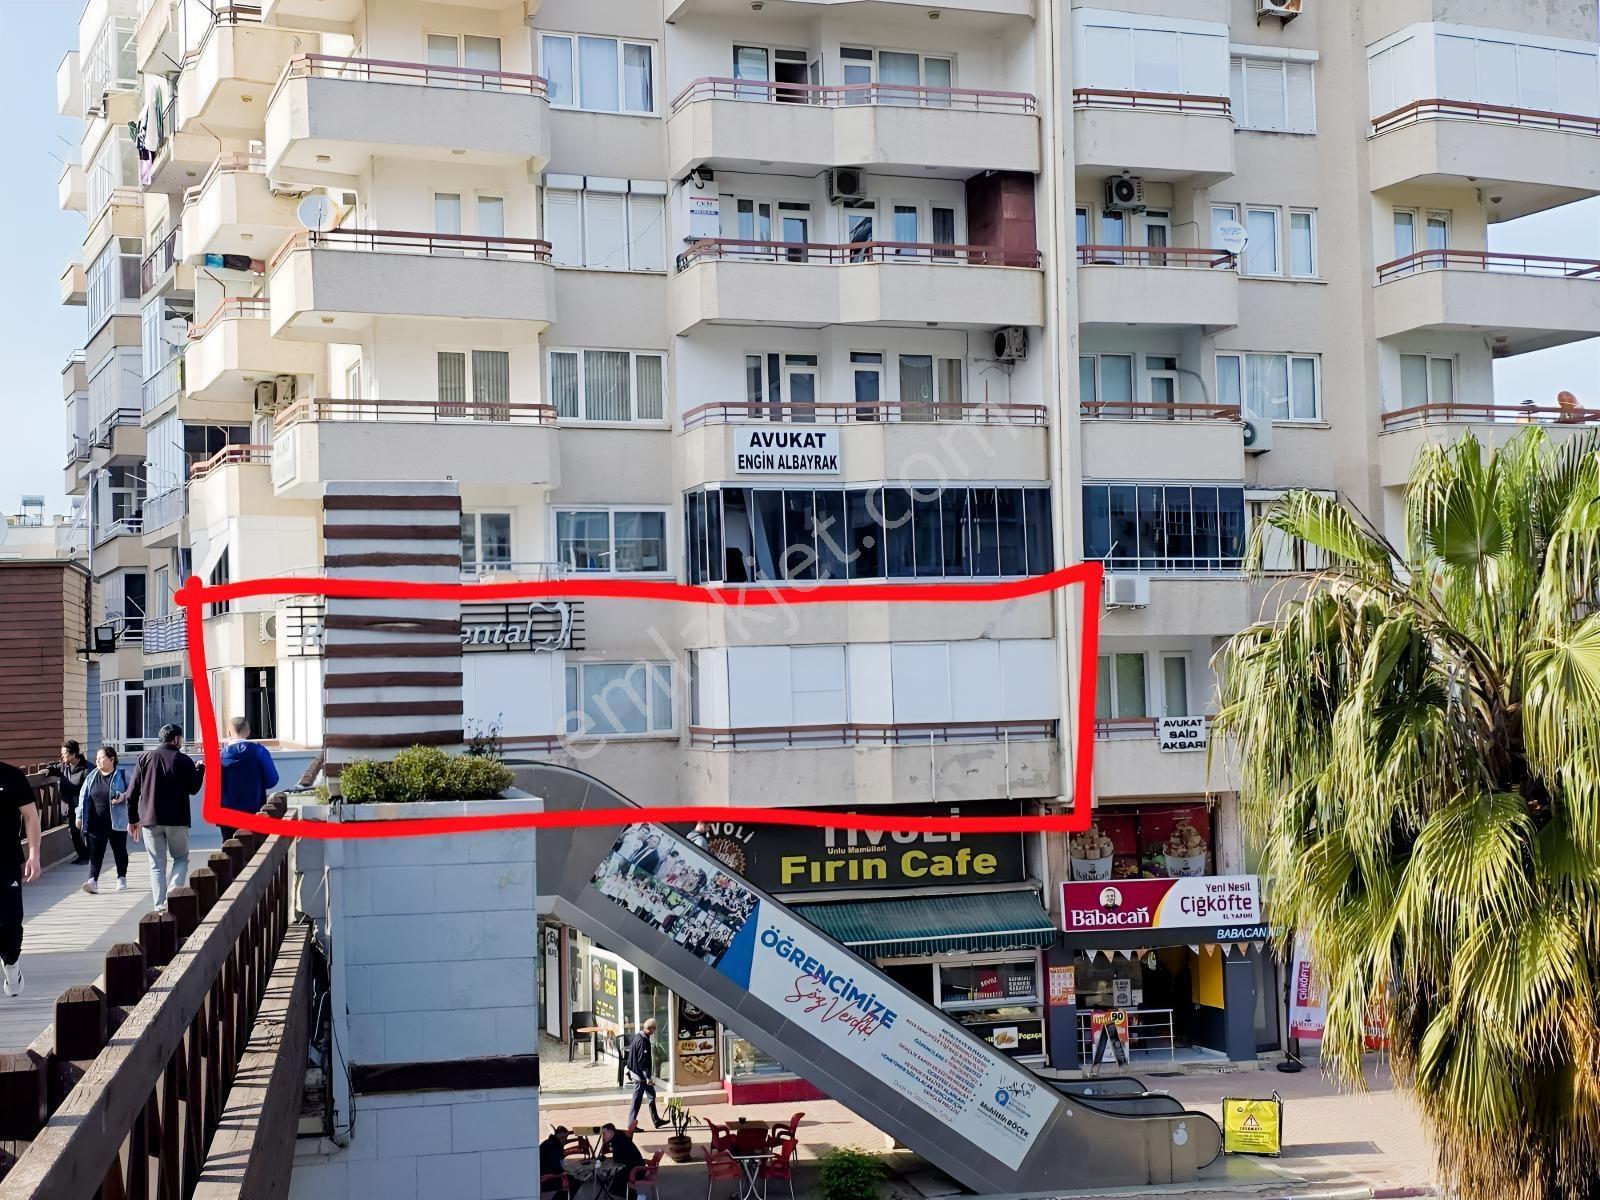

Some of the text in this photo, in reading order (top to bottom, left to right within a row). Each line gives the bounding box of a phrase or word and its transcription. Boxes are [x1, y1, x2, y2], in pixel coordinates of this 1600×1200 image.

[750, 431, 827, 449] AVUKAT
[738, 451, 838, 470] ENGİN ALBAYRAK
[461, 616, 533, 644] ental
[1163, 719, 1203, 728] AVUKAT
[705, 822, 755, 844] VOLİ
[781, 847, 997, 884] Fırın Cafe
[1206, 881, 1252, 893] Yeni Nesil
[1180, 893, 1252, 917] Çiğköfte
[1216, 927, 1267, 939] BABACAN
[760, 925, 897, 1029] ÖĞRENCİMİZE
[785, 973, 828, 1013] Söz
[1006, 1117, 1030, 1138] BÖCEK
